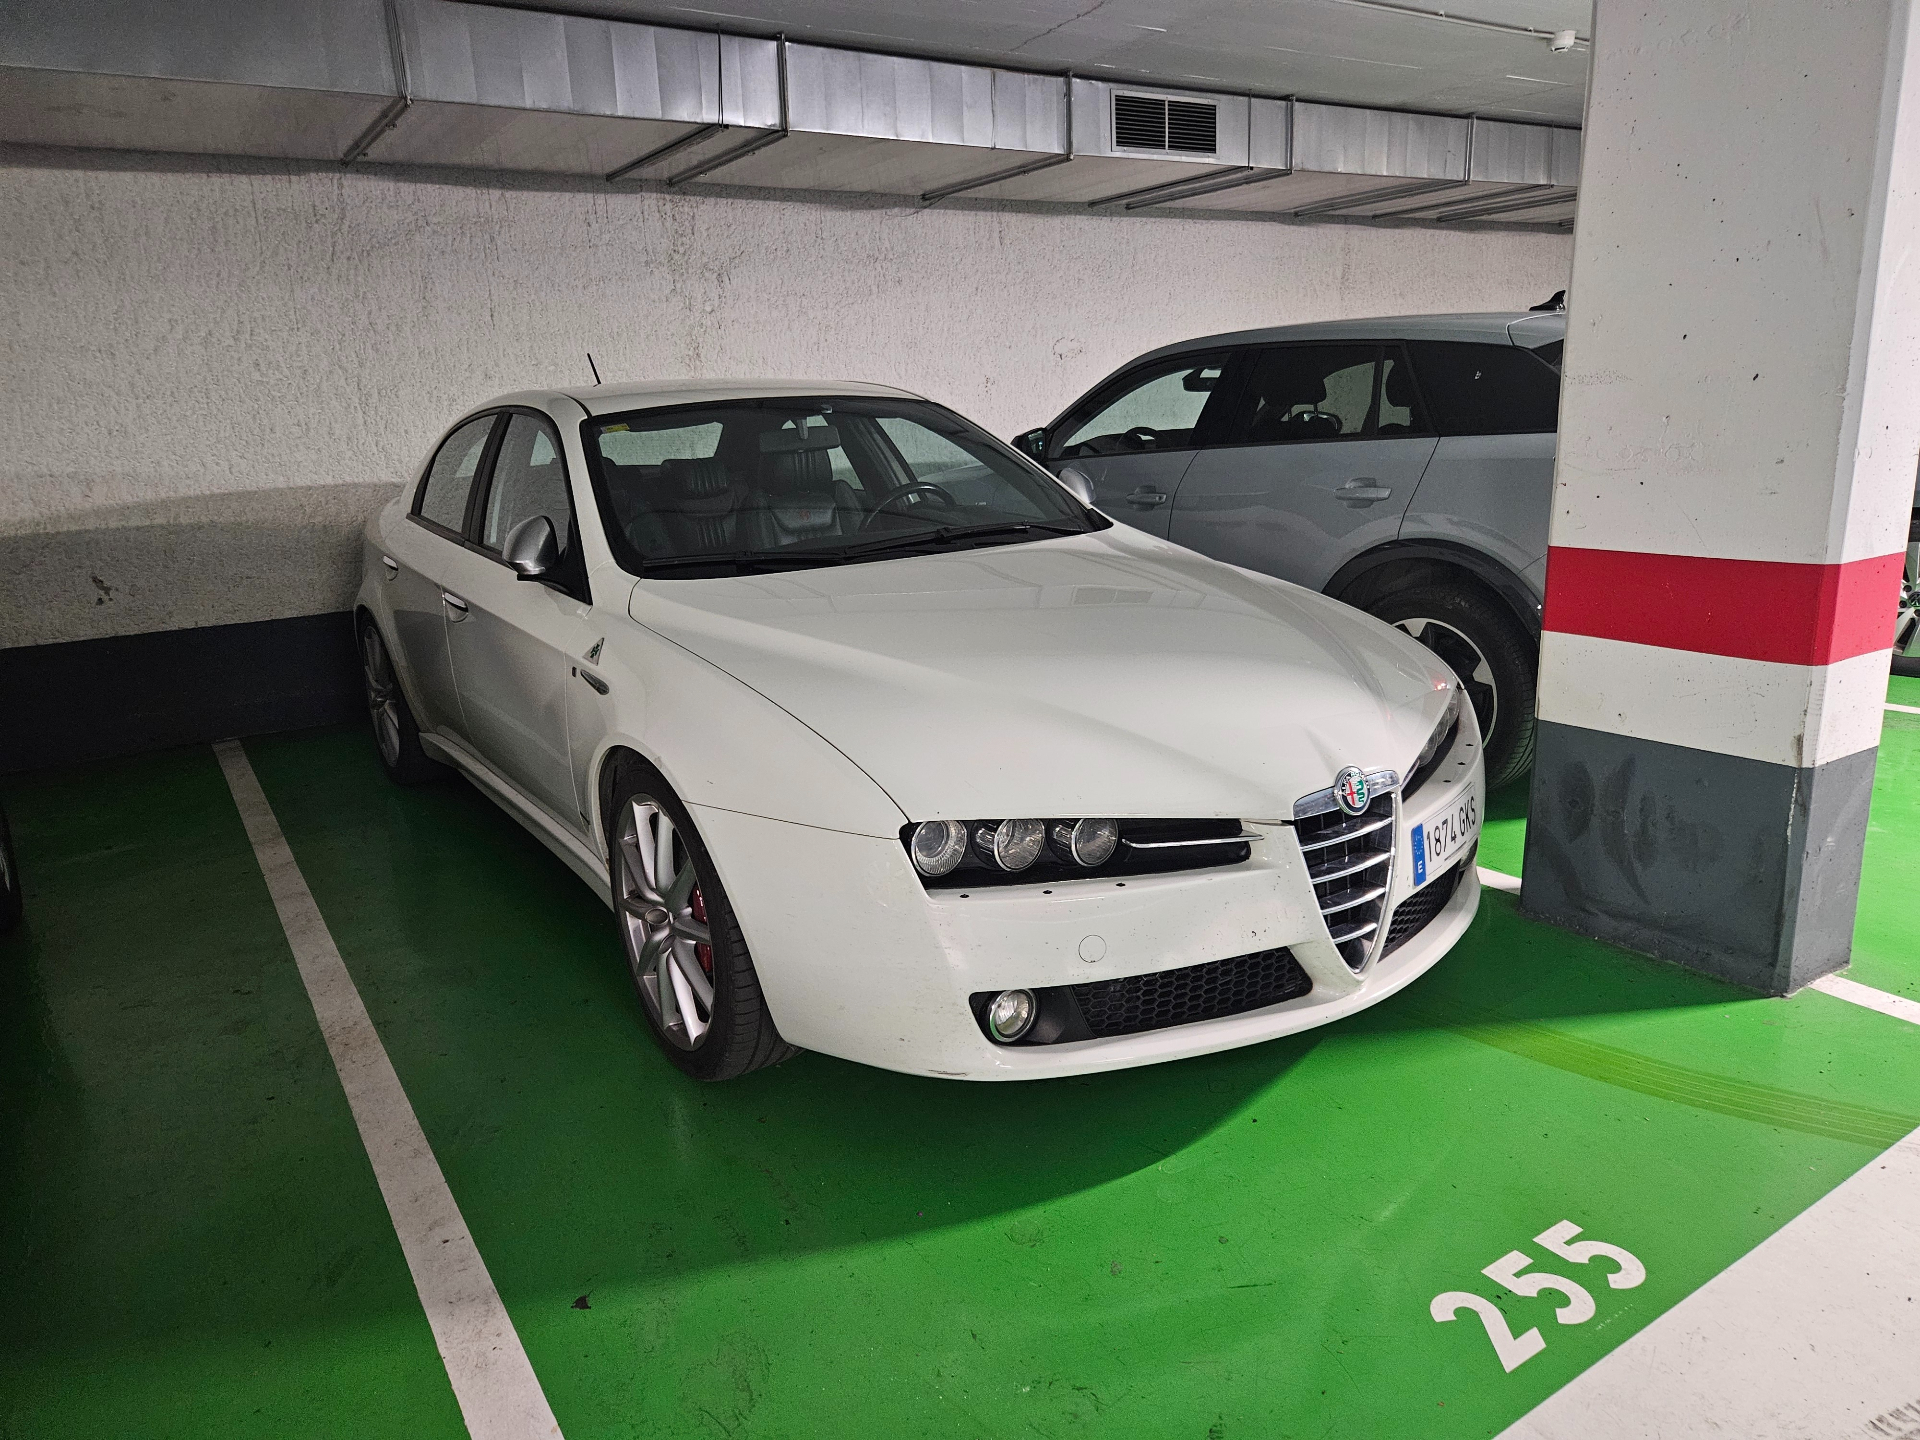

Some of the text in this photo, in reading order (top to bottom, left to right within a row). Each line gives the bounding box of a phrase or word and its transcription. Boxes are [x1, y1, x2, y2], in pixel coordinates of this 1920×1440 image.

[1426, 796, 1476, 862] 1874 GKS
[1417, 860, 1424, 874] E
[1430, 1219, 1647, 1374] 255
